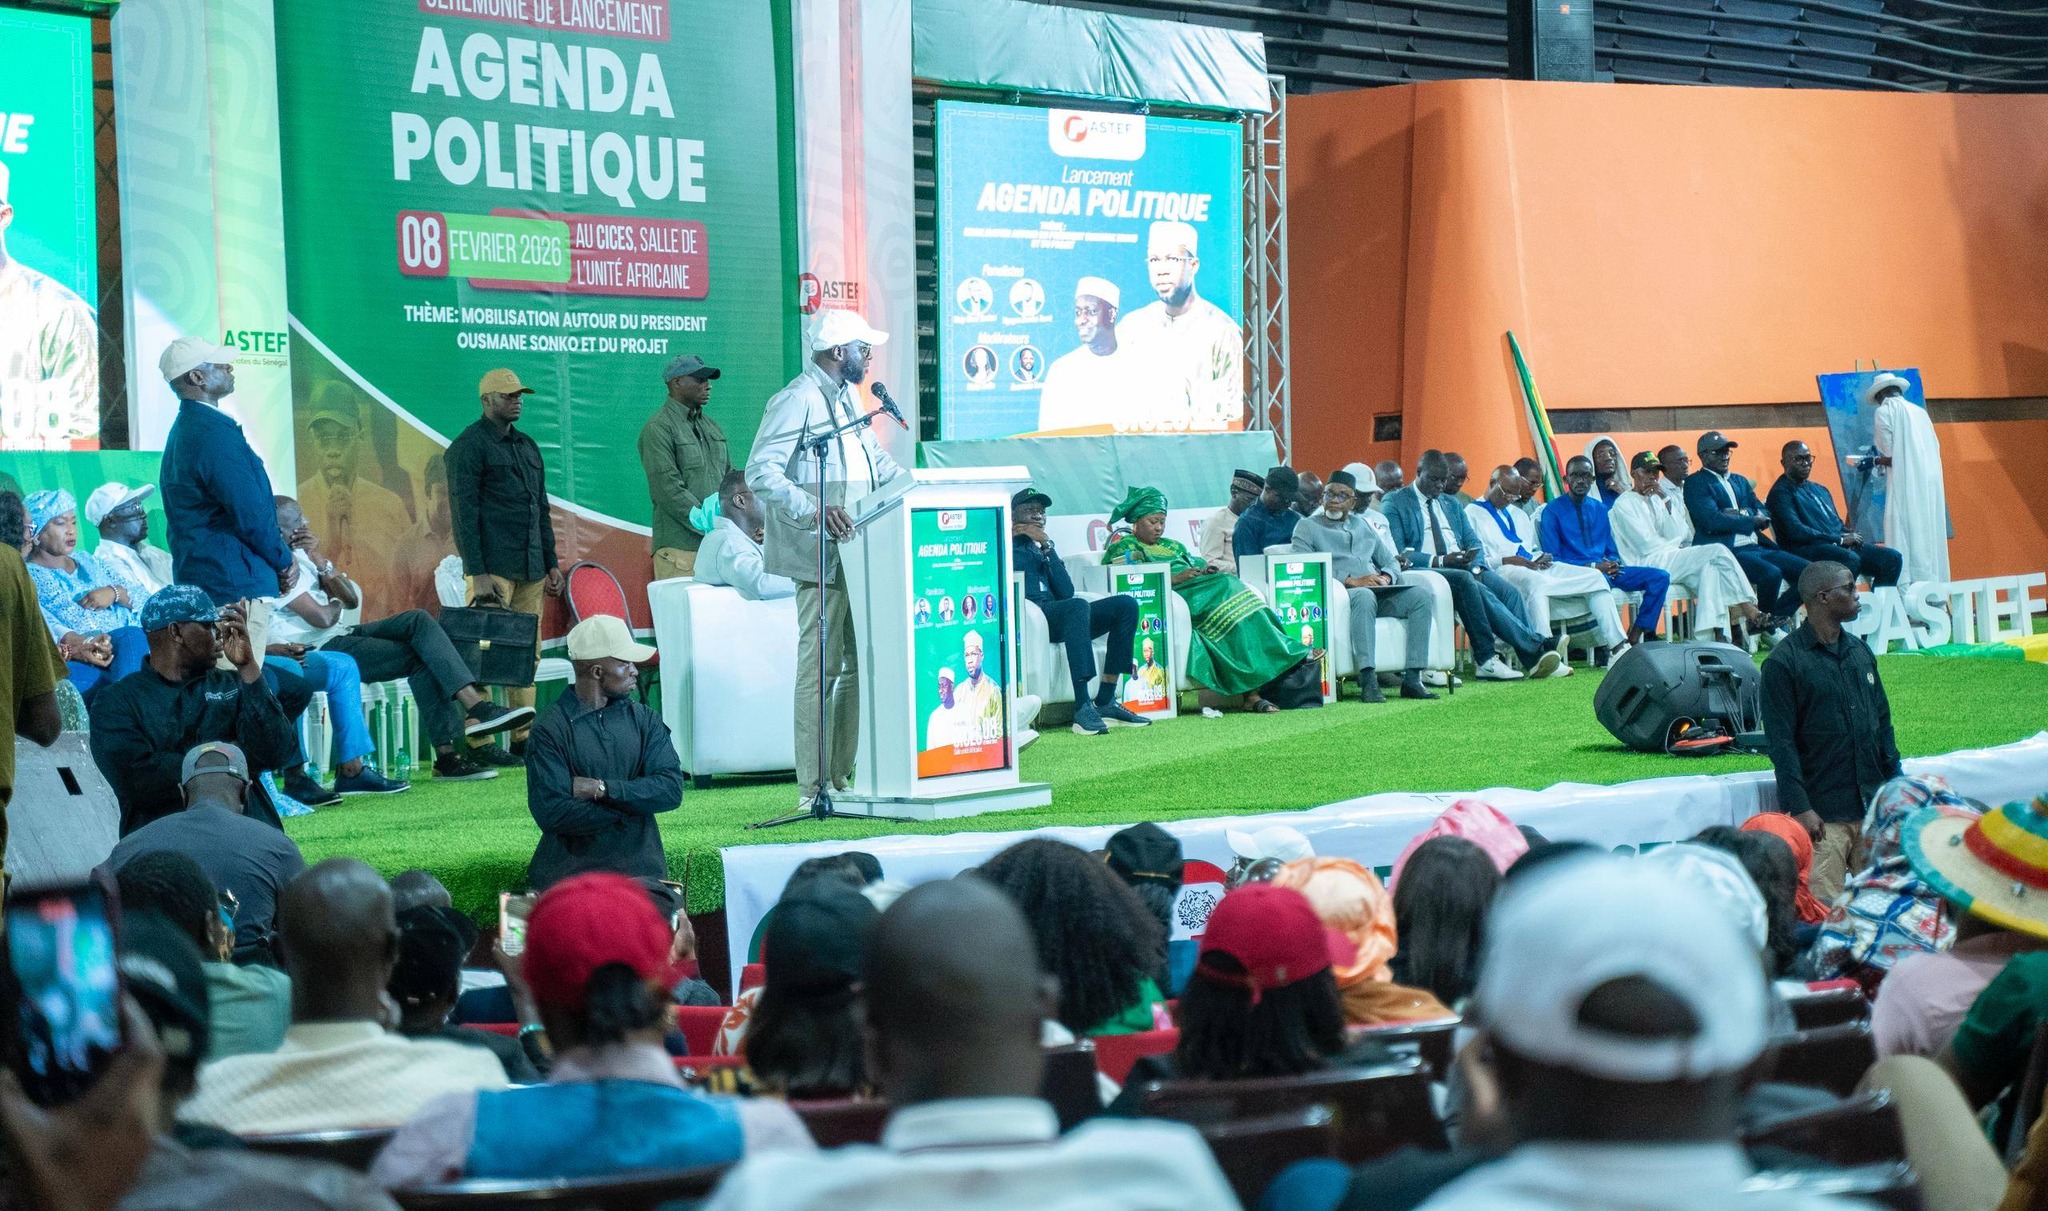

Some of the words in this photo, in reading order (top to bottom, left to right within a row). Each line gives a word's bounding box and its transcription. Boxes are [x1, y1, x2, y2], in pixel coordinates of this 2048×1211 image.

[427, 0, 528, 21] MONIE
[534, 0, 555, 25] DE
[561, 0, 663, 36] LANCEMENT
[411, 26, 675, 118] AGENDA
[391, 111, 706, 208] POLITIQUE
[1062, 165, 1134, 187] Lancement
[977, 183, 1080, 216] AGENDA
[1087, 188, 1211, 222] POLITIQUE
[402, 215, 441, 269] 08
[449, 230, 517, 264] FEVRIER
[520, 235, 562, 267] 2026
[576, 222, 595, 249] AU
[596, 225, 637, 253] CICES,
[639, 227, 679, 253] SALLE
[681, 229, 698, 254] DE
[577, 258, 623, 287] L'UNITÉ
[626, 261, 690, 290] AFRICAINE
[404, 301, 458, 324] THÈME:
[461, 307, 558, 328] MOBILISATION
[563, 313, 617, 330] AUTOUR
[619, 314, 638, 331] DU
[641, 315, 707, 332] PRESIDENT
[457, 332, 528, 351] OUSMANE
[530, 335, 578, 353] SONKO
[581, 337, 597, 353] ET
[599, 337, 618, 353] DU
[621, 338, 668, 354] PROJET
[252, 358, 261, 366] du
[262, 358, 288, 368] Sénégal
[918, 543, 949, 558] AGENDA
[949, 541, 988, 556] POLITIQUE
[1842, 572, 2047, 655] PASTEF
